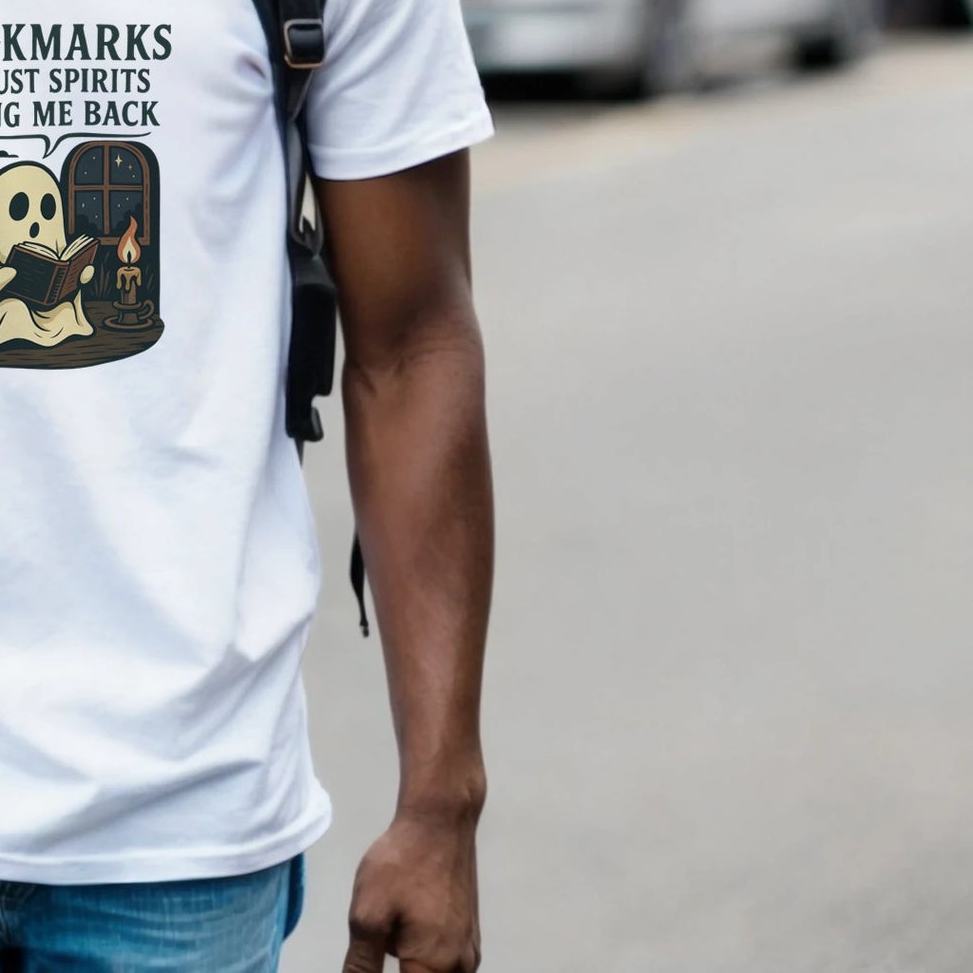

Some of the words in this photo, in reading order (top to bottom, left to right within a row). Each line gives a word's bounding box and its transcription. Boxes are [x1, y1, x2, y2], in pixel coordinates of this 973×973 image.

[50, 69, 150, 93] SPIRITS
[33, 101, 72, 126] ME
[85, 101, 160, 126] BACK
